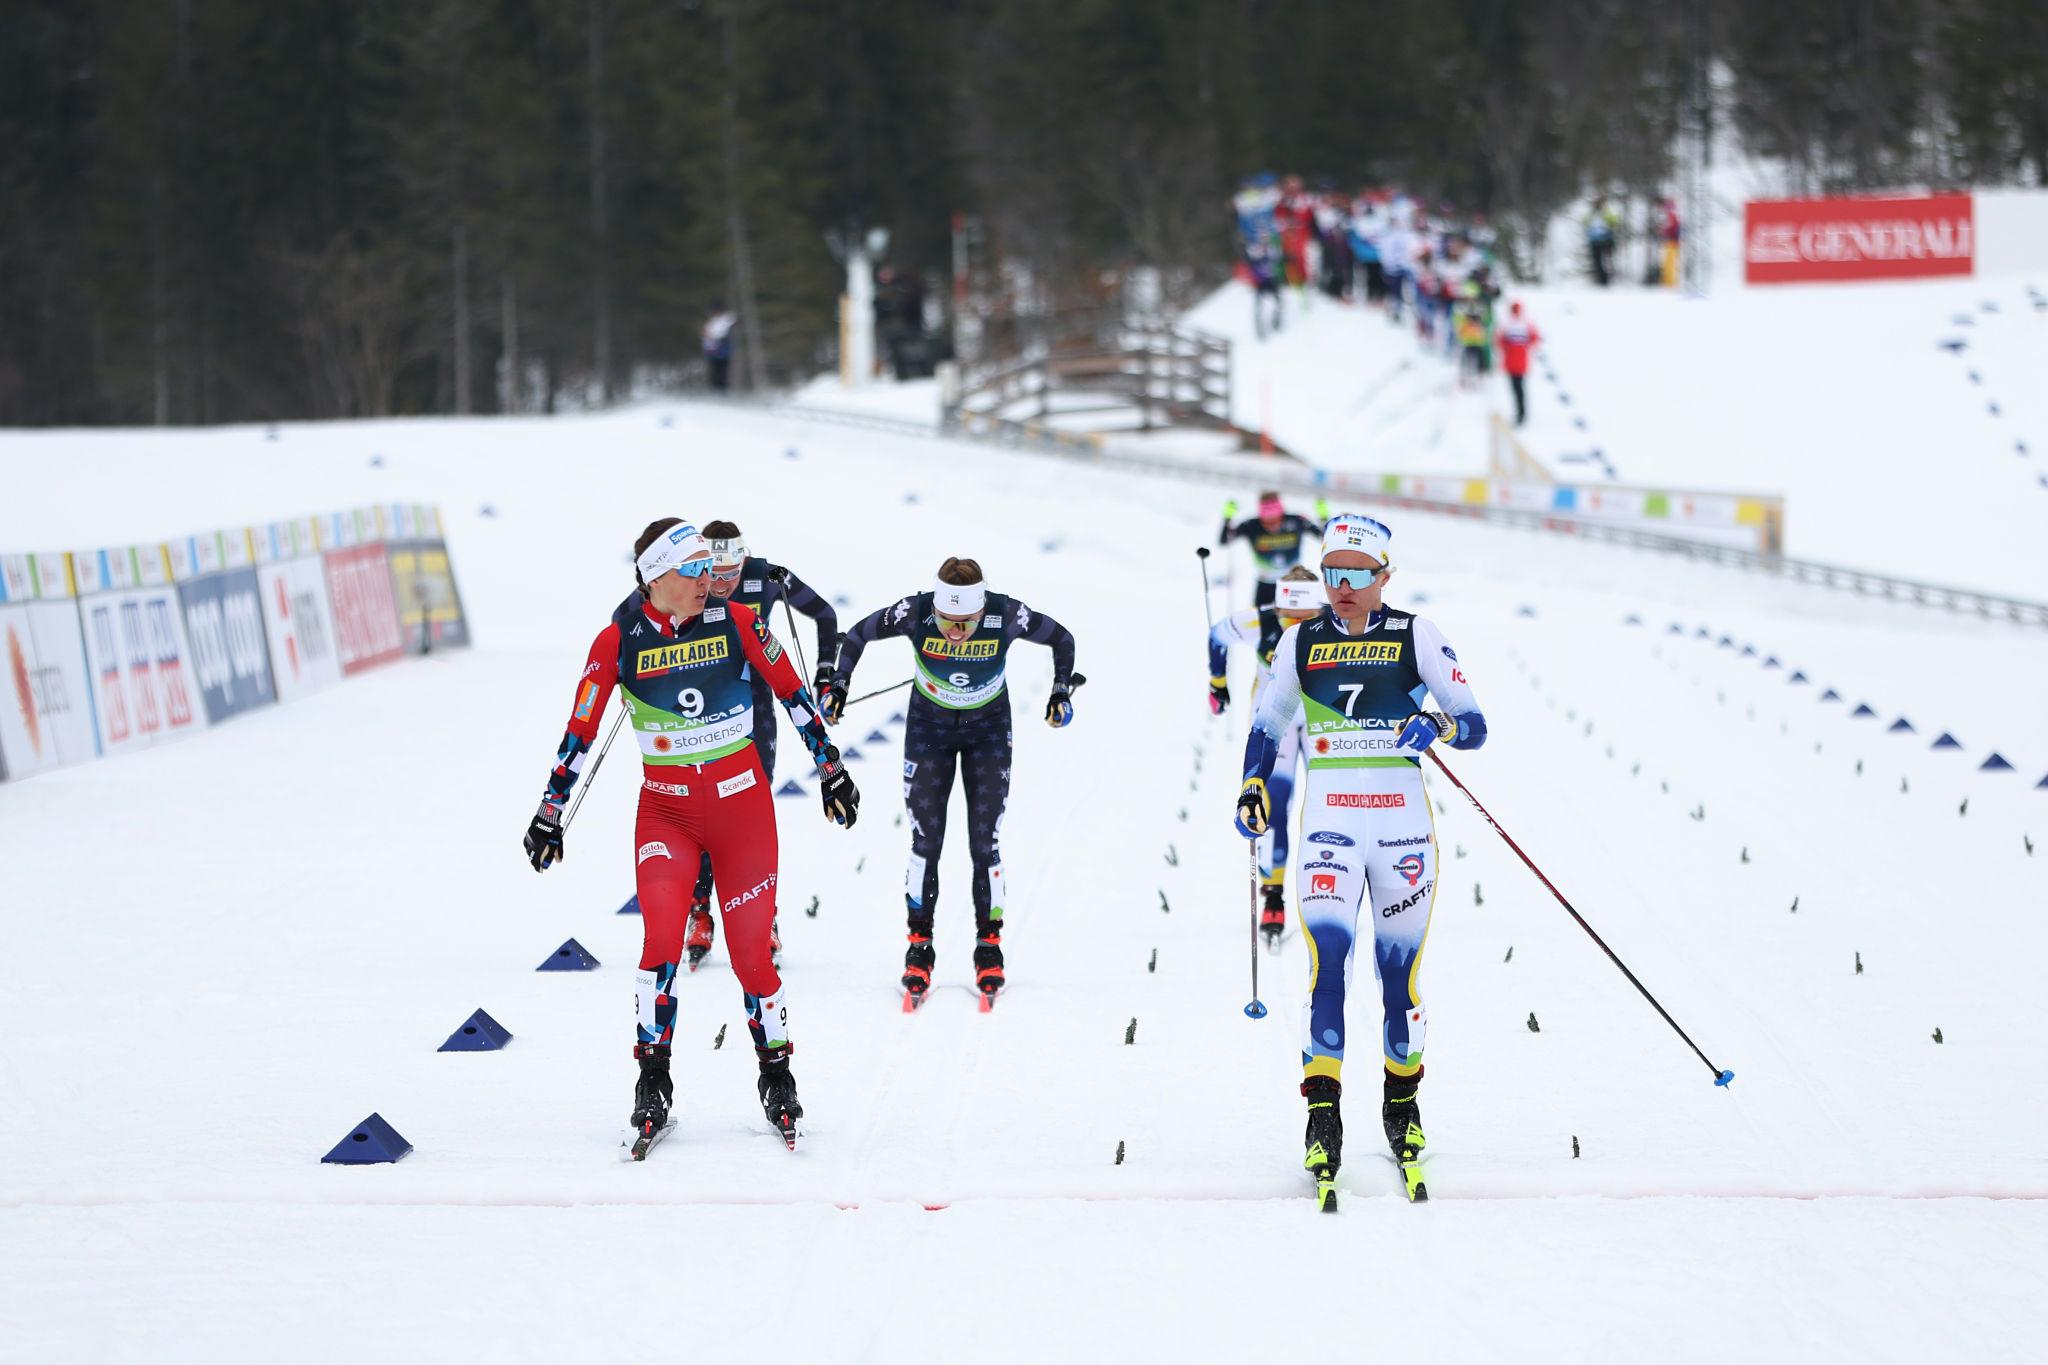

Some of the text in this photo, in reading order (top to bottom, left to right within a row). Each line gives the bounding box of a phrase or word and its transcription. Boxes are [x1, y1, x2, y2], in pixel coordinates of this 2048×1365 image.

[640, 640, 726, 671] BLÅKLÄDER
[1311, 643, 1397, 662] BLÅKLÄDER
[948, 672, 970, 687] 6
[677, 687, 704, 718] 9
[1338, 684, 1364, 717] 7
[664, 711, 727, 730] PLANICA
[1323, 718, 1386, 730] PLANICA
[674, 723, 743, 749] storaenso
[646, 779, 676, 793] SPAR
[722, 776, 753, 793] Scandic
[1328, 794, 1404, 807] BAUHAUS
[1313, 832, 1348, 846] Ford
[1377, 836, 1426, 848] Sundström
[640, 843, 665, 855] Gilde
[1303, 861, 1349, 873] SCANIA
[724, 878, 770, 913] CRAFT
[1302, 894, 1346, 903] SVENSKA SPEL
[1382, 887, 1427, 918] CRAFT
[780, 1006, 788, 1027] 9
